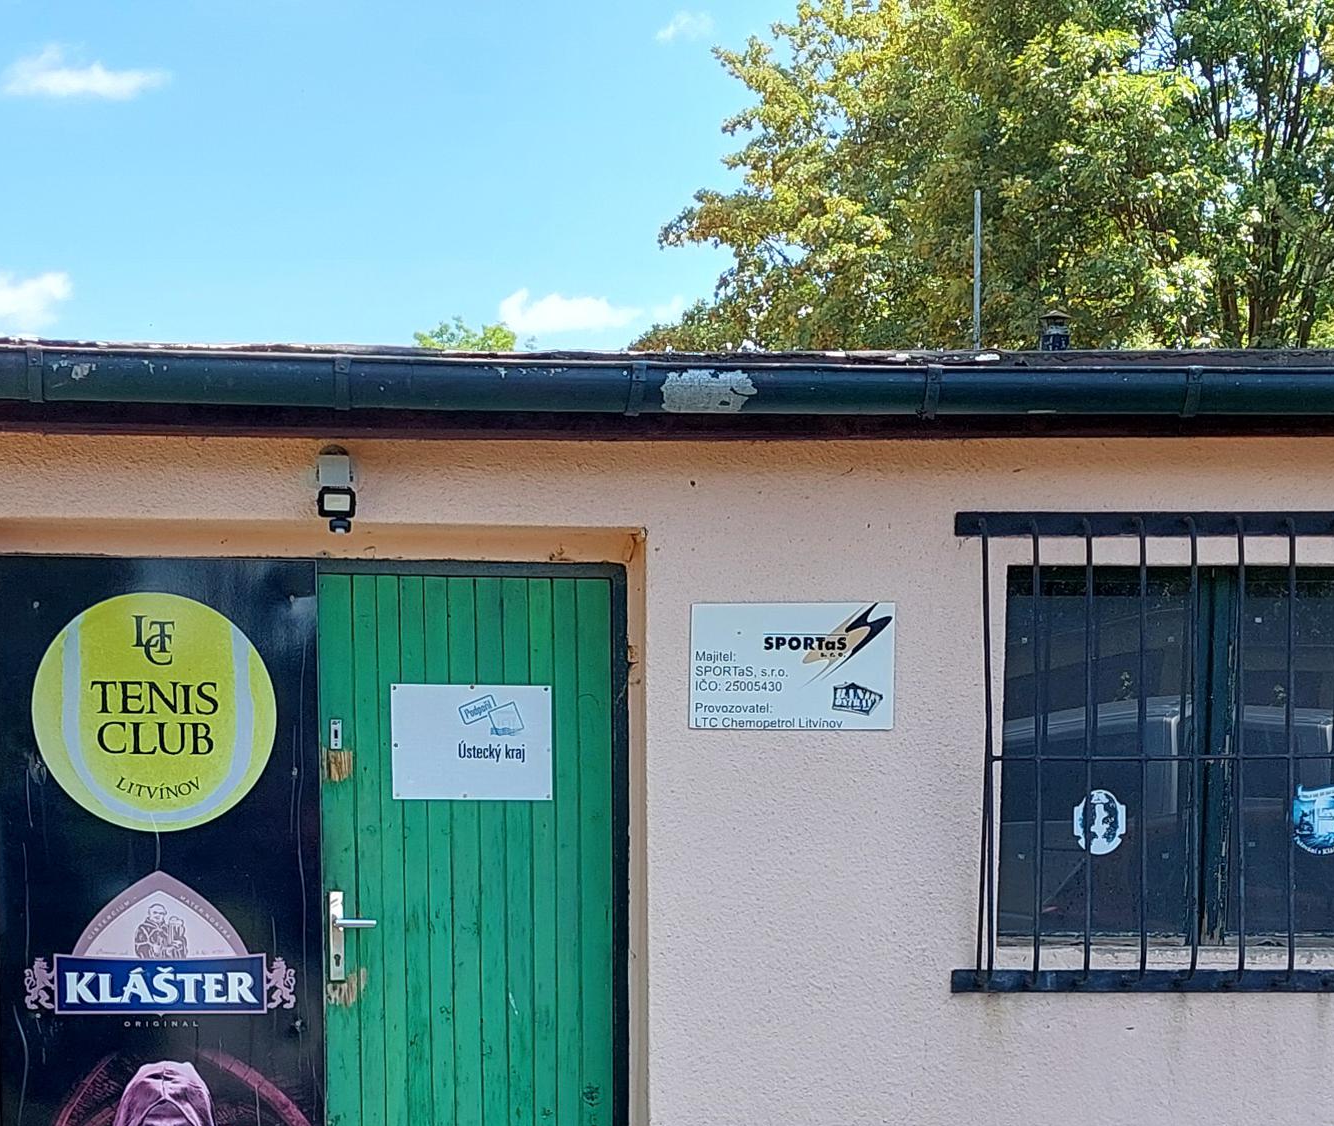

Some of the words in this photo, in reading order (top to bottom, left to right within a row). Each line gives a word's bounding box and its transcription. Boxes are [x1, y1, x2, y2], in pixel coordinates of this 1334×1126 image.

[763, 636, 847, 651] SPORTaS
[695, 650, 736, 663] Majitel:
[695, 665, 757, 678] SPORTaS,
[761, 667, 788, 677] s.r.o.
[695, 680, 721, 692] IČO:
[725, 680, 782, 692] 25005430
[90, 680, 219, 715] TENIS
[695, 702, 773, 714] Provozovatel:
[694, 717, 718, 729] LTC
[721, 717, 795, 729] Chemopetrol
[798, 717, 843, 729] Litvínov
[96, 721, 215, 755] CLUB
[457, 740, 502, 763] Ústecký
[505, 743, 526, 763] kraj
[116, 775, 202, 800] LITVÍNOV
[64, 965, 259, 1005] KLÁŠTER
[123, 1019, 200, 1028] ORIGINAL
